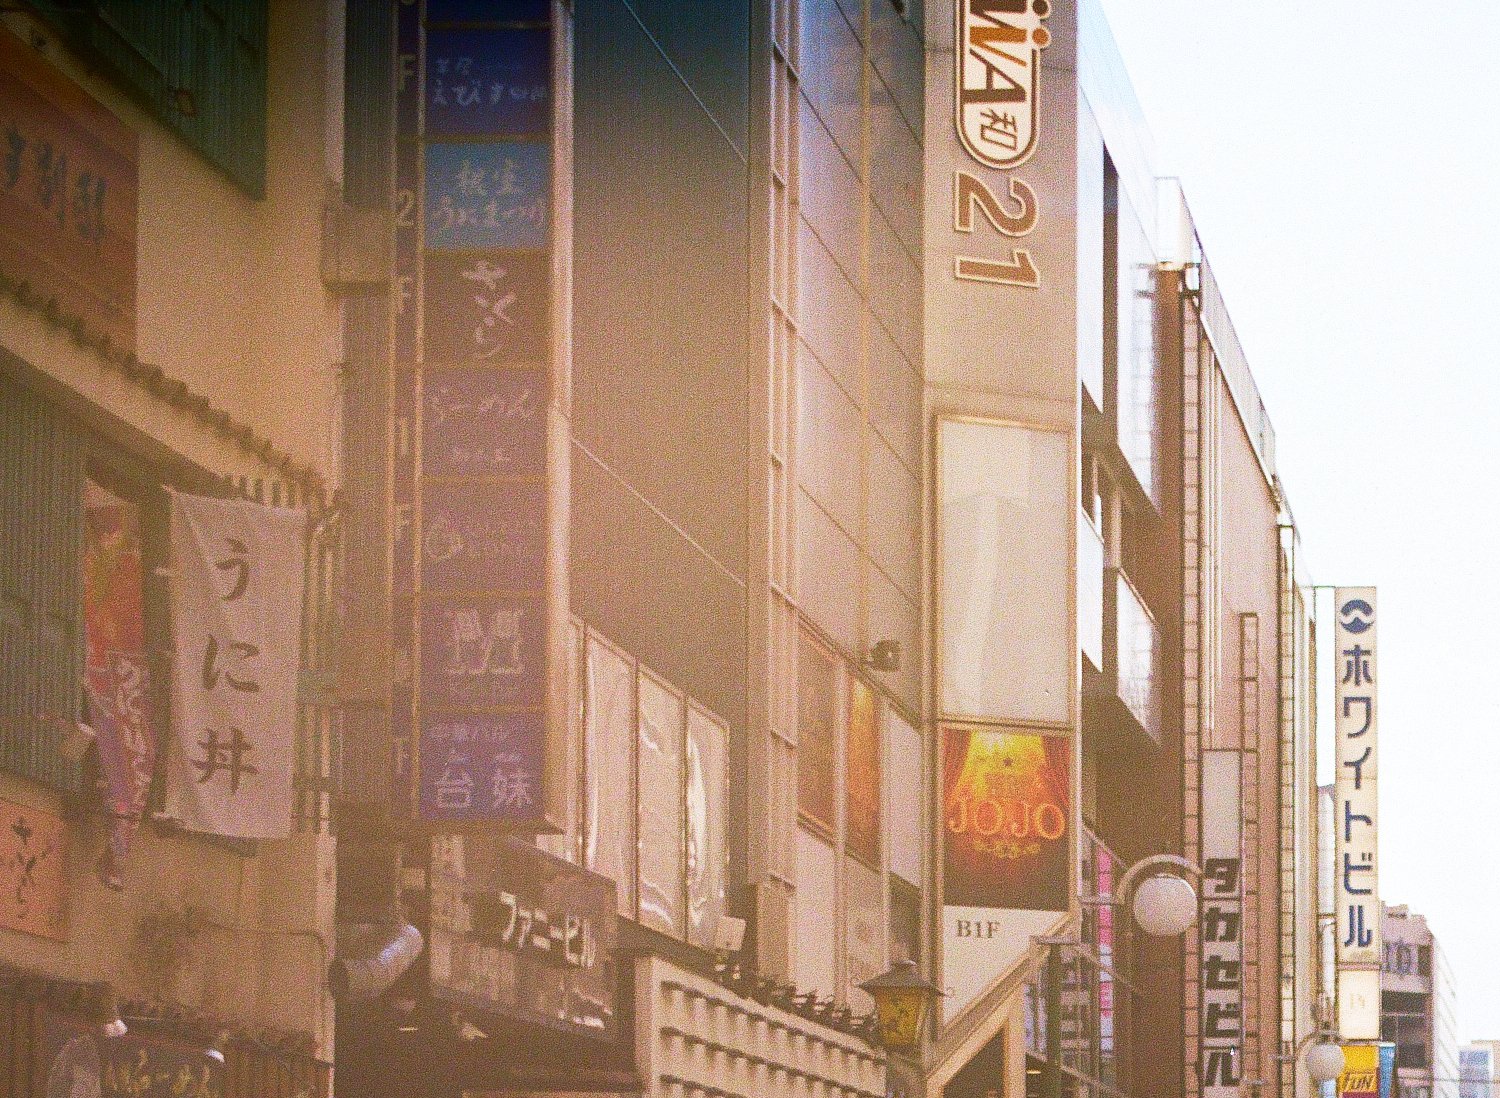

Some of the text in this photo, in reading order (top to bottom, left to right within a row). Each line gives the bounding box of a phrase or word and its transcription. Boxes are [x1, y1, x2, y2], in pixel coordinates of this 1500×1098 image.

[192, 537, 260, 796] うに丼
[948, 796, 1066, 840] JOJO
[1342, 644, 1373, 948] ホワイトビル
[955, 919, 1002, 939] B1F
[1204, 858, 1241, 1087] タカセビル
